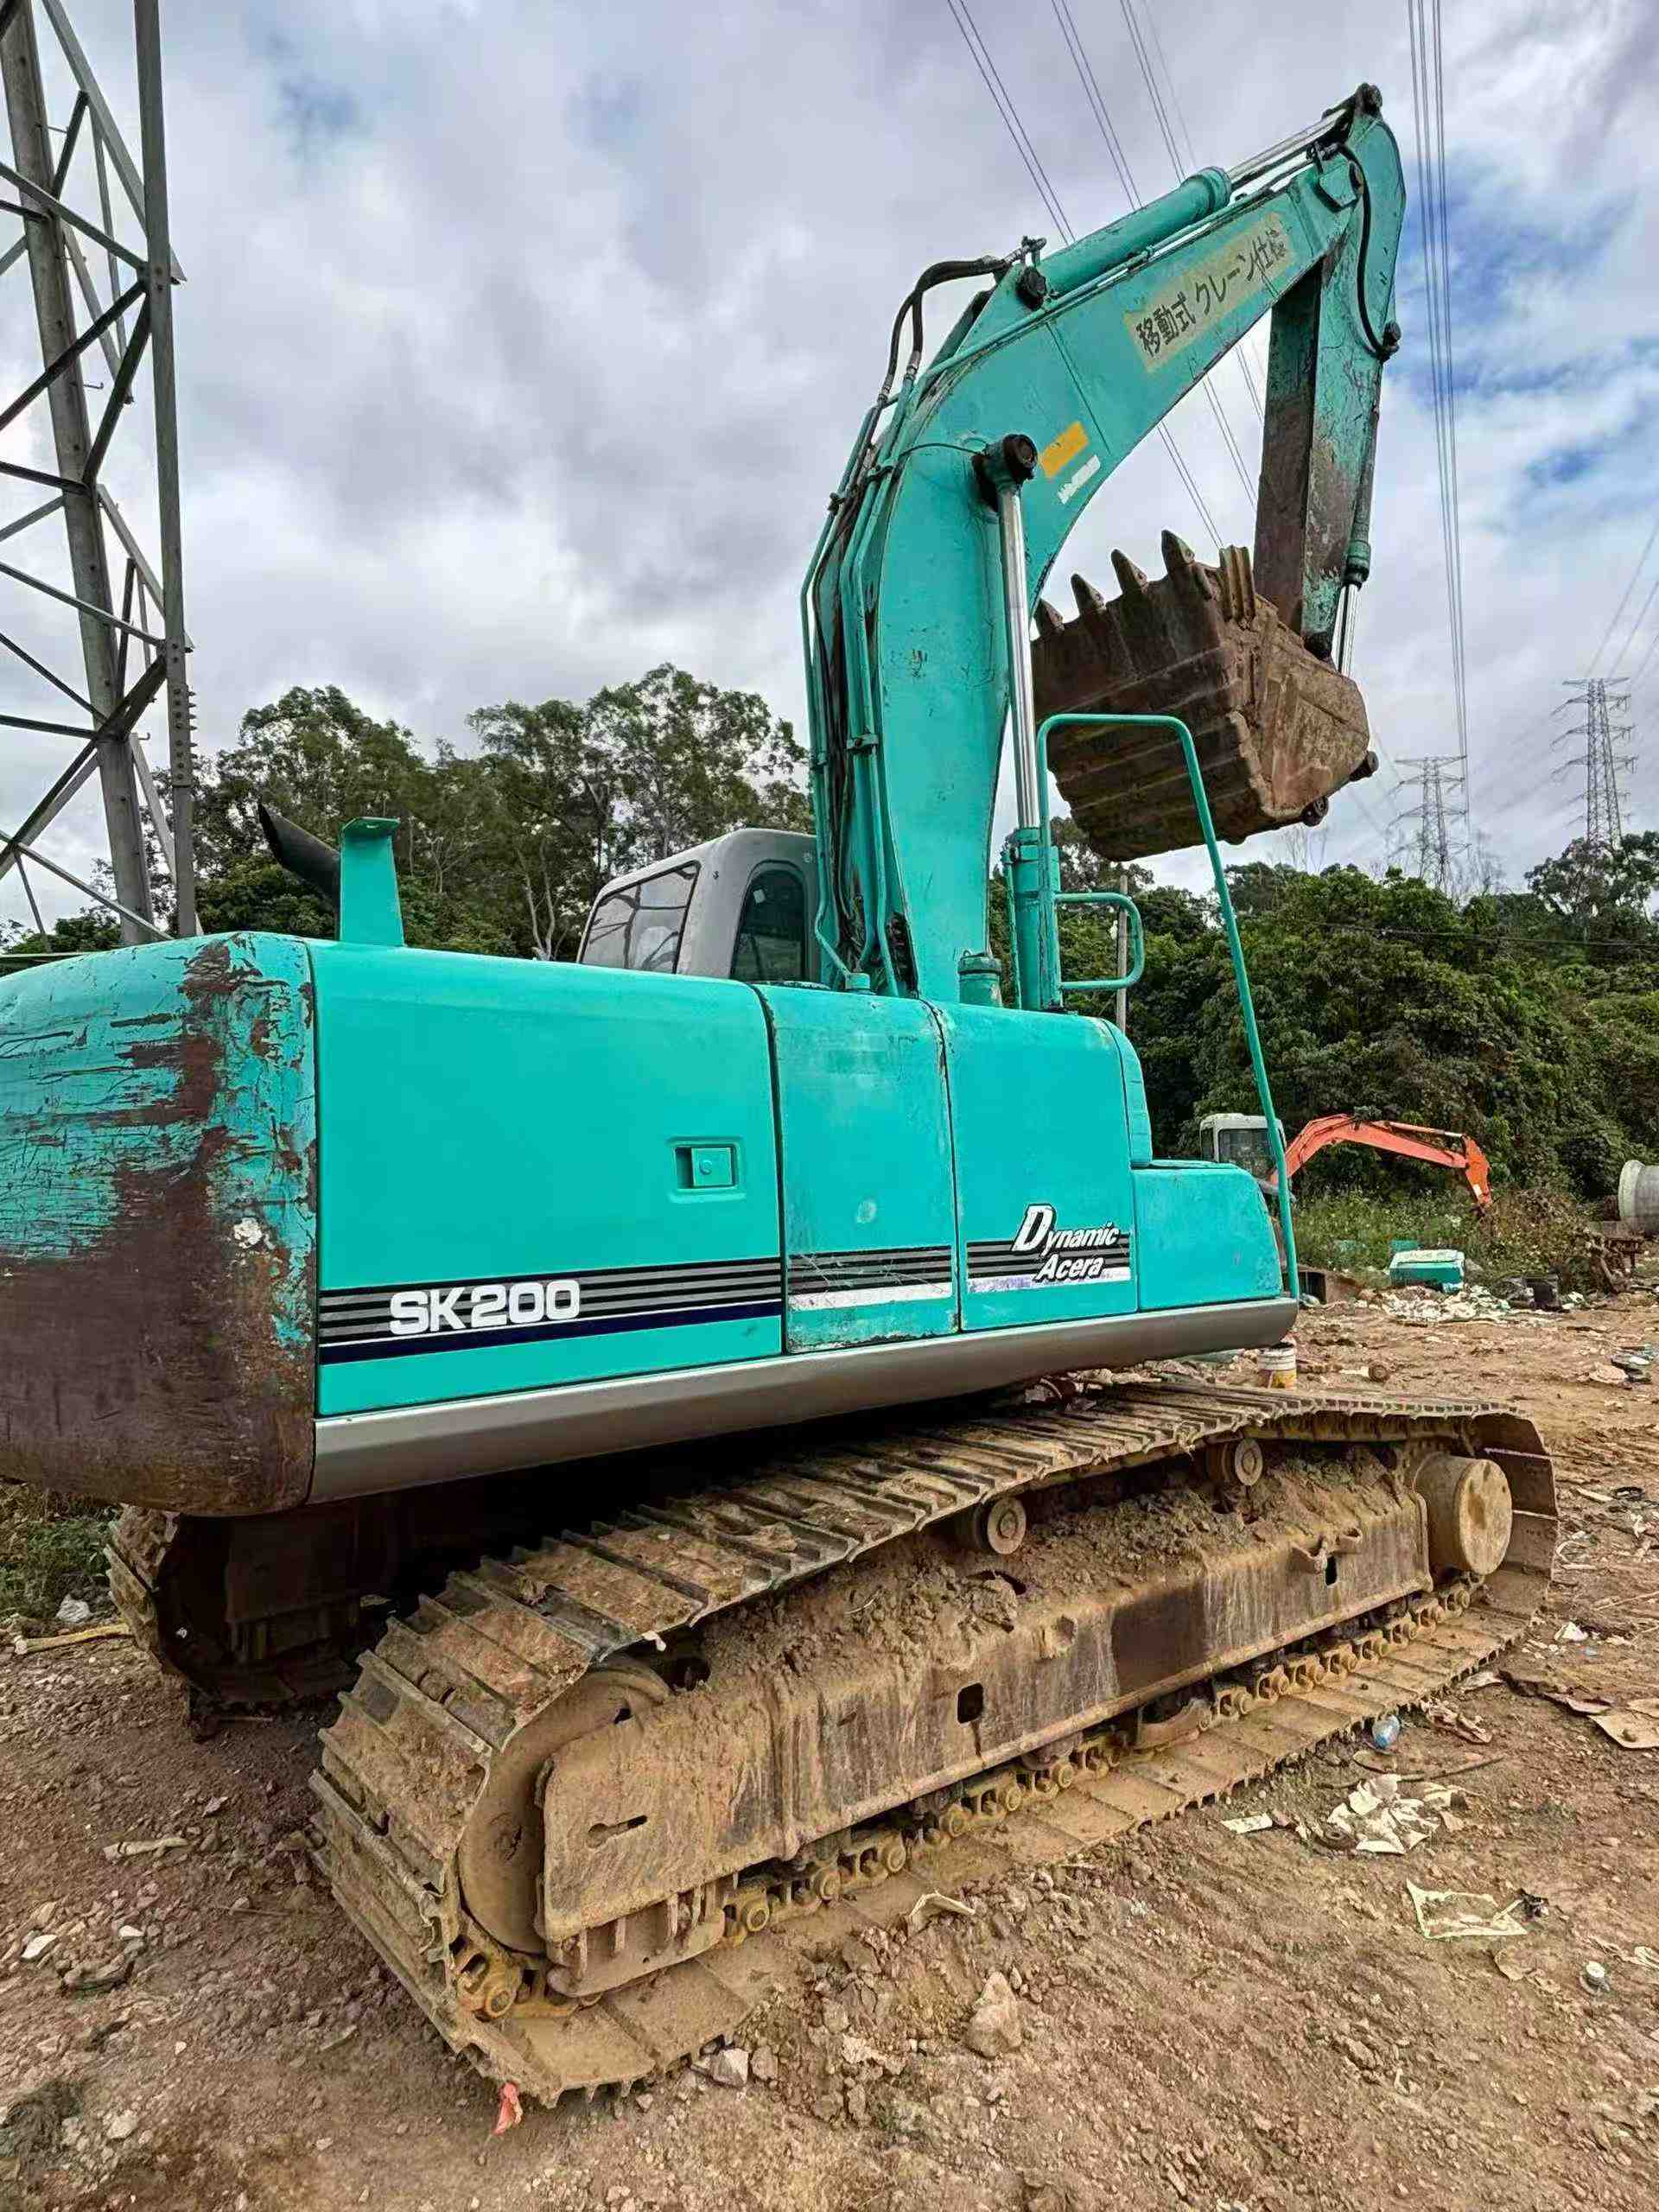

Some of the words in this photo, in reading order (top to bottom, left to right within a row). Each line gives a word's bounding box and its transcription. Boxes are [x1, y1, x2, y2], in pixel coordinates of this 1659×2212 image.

[1012, 1204, 1120, 1256] Dynamic
[1035, 1254, 1104, 1281] Acera
[390, 1280, 580, 1335] SK200
